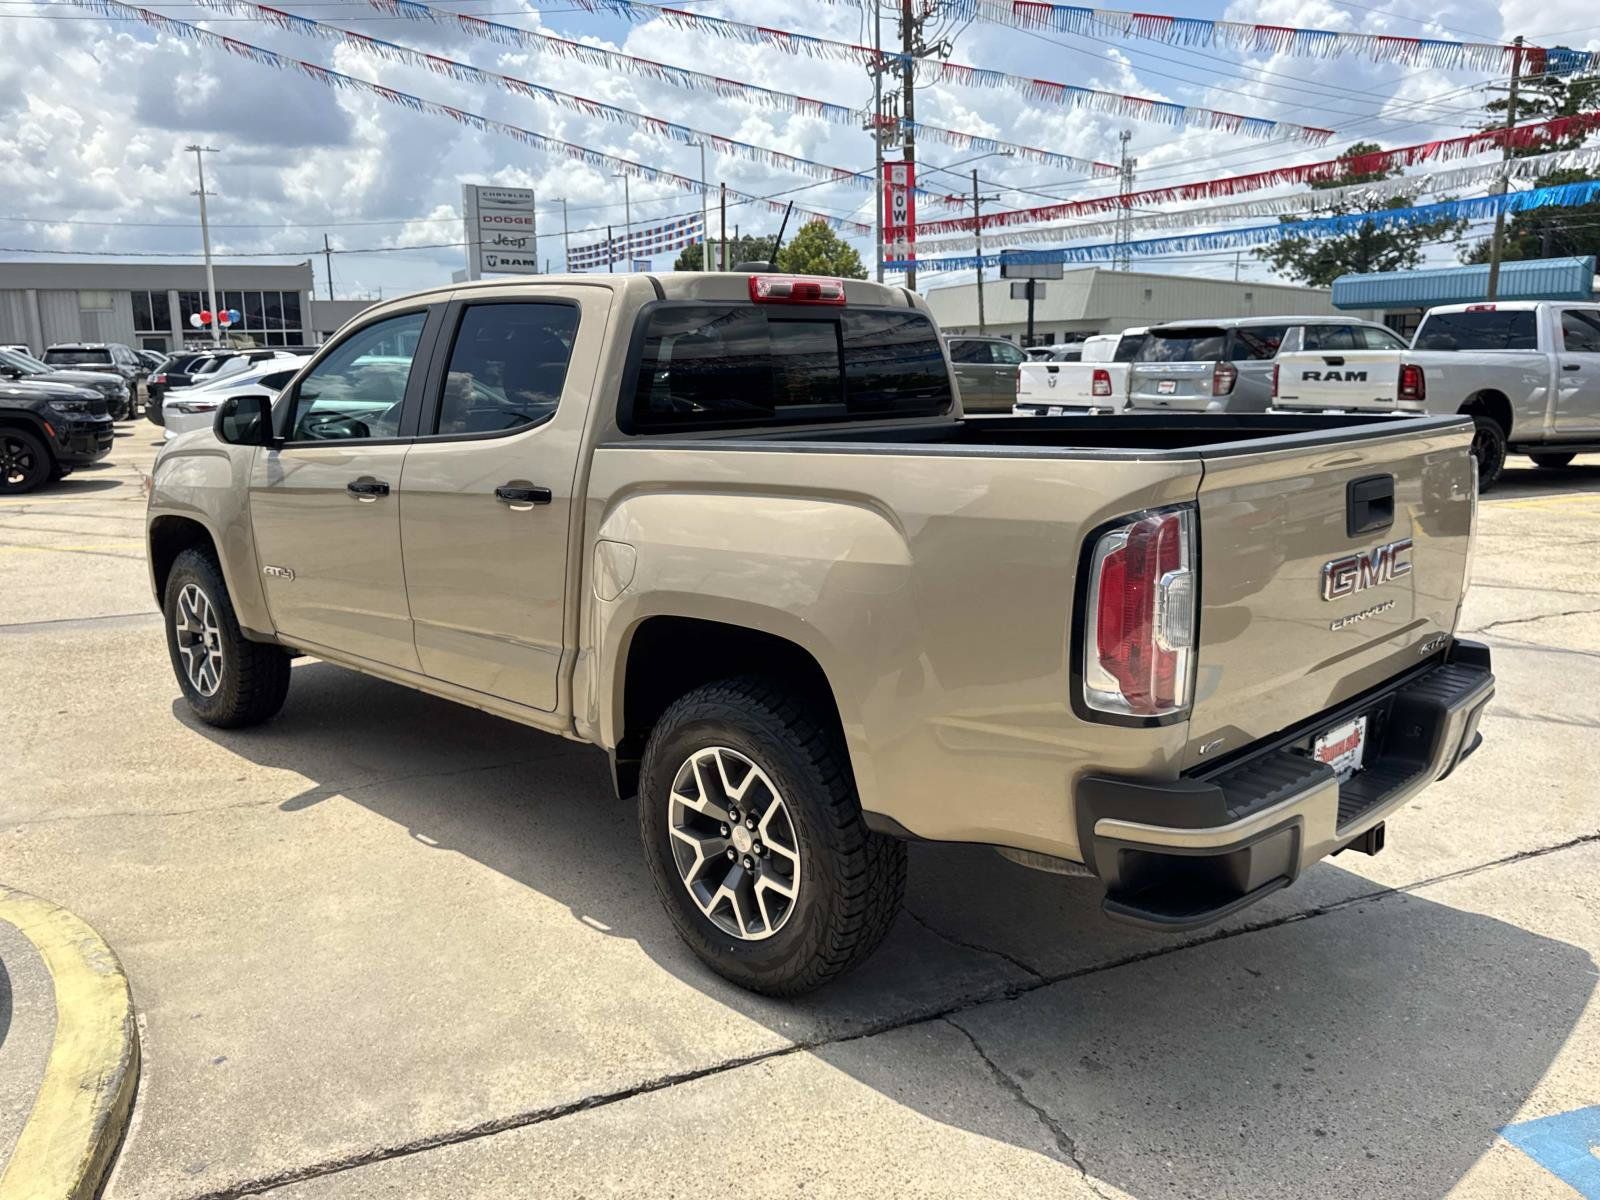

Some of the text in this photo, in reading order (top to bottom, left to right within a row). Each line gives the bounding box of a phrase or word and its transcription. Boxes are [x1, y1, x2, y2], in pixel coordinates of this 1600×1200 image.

[482, 191, 531, 199] CHRYSLER
[482, 215, 533, 225] DODGE
[493, 233, 526, 249] Jeep
[500, 258, 535, 267] RAM
[1301, 371, 1368, 382] RAM
[1321, 537, 1413, 601] GMC
[1329, 600, 1396, 631] CANYON
